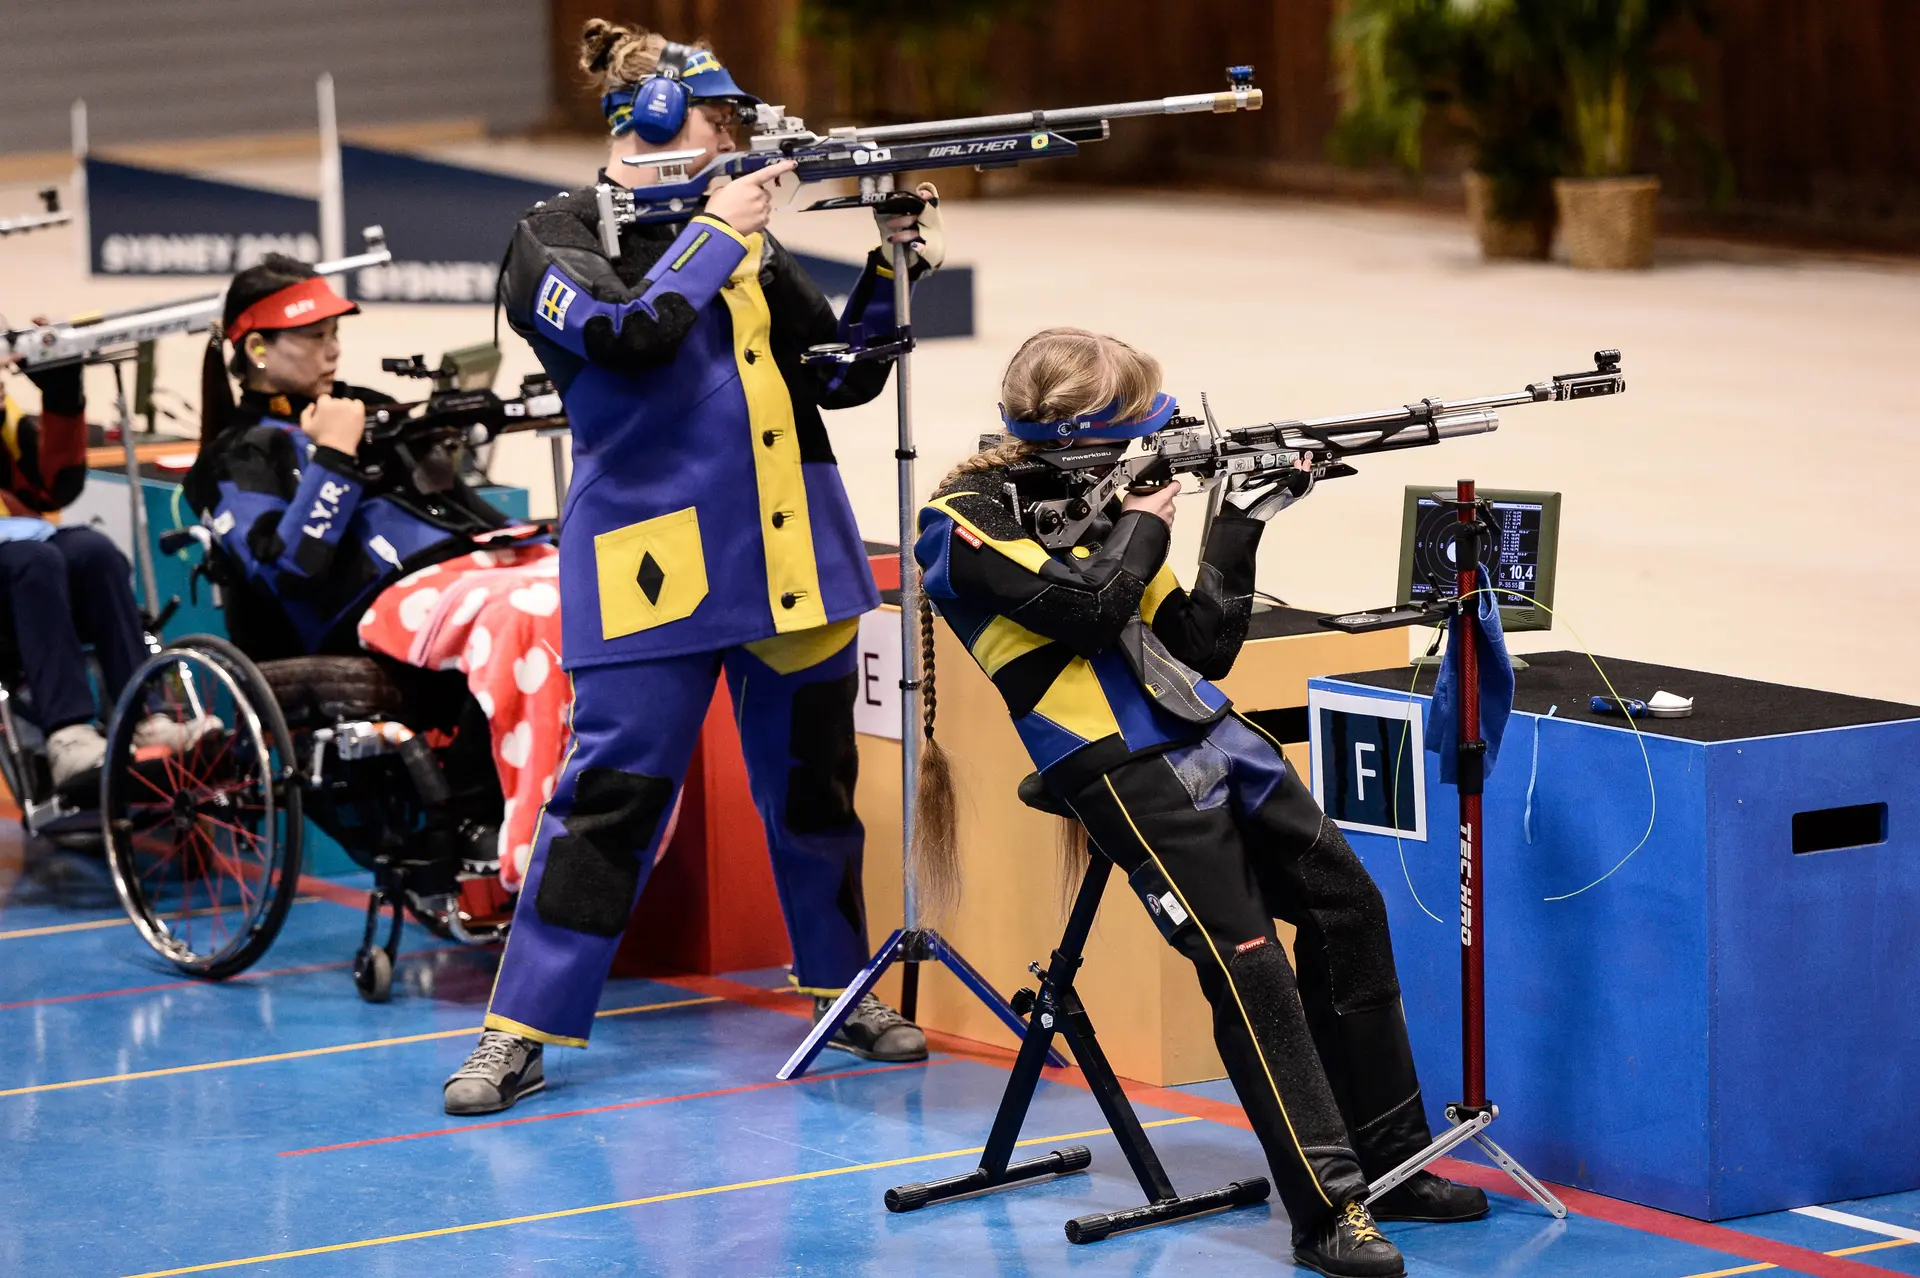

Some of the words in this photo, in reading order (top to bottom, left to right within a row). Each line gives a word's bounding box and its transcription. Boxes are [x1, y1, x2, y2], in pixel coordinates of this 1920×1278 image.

[928, 140, 1018, 157] WALTHER
[861, 191, 887, 204] 800
[102, 233, 232, 272] SYDNEY
[1509, 564, 1534, 580] 10.4
[1507, 594, 1524, 602] READY
[864, 651, 882, 707] E
[1355, 741, 1376, 801] F
[1460, 822, 1472, 947] TEC-HRO
